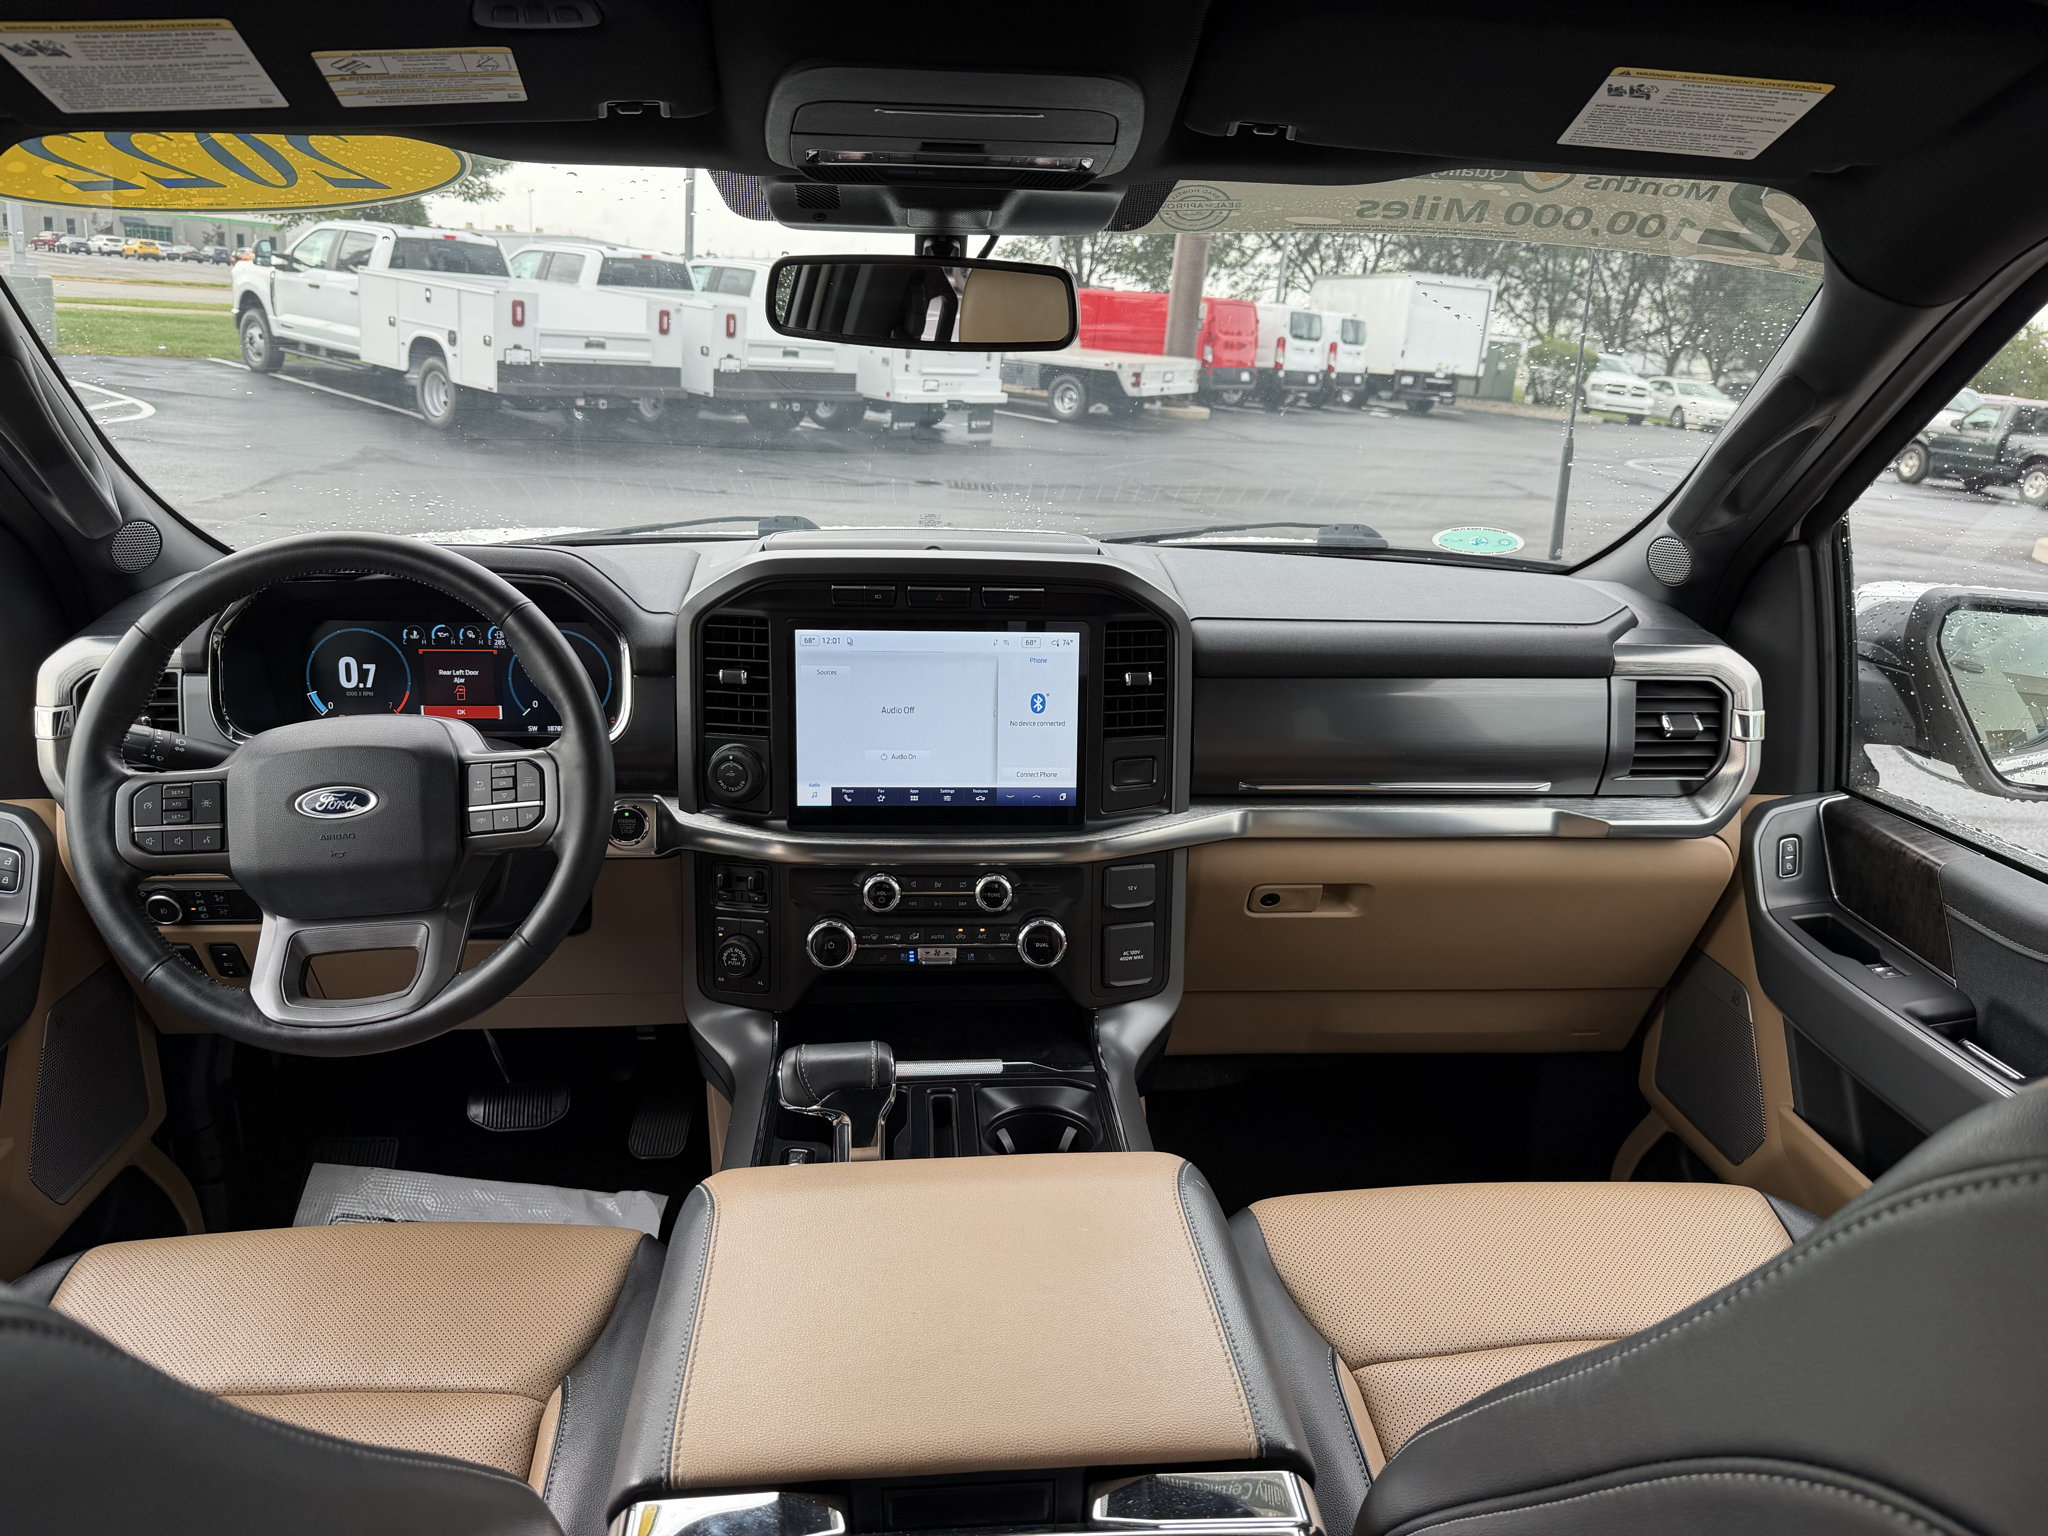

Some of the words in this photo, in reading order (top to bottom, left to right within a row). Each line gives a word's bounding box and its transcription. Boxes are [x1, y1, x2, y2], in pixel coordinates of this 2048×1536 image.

[822, 637, 841, 645] 12:01
[1062, 639, 1074, 647] 74°
[1029, 657, 1048, 665] Phone
[338, 656, 377, 689] 0.7
[327, 701, 334, 710] 0
[388, 701, 393, 710] 7
[532, 700, 539, 708] 0
[881, 706, 902, 715] Audio
[903, 706, 916, 715] Off
[1018, 719, 1038, 727] device
[1038, 719, 1066, 727] connected
[891, 753, 908, 761] Audio
[908, 753, 917, 761] On
[717, 779, 728, 790] PRO
[728, 780, 746, 792] TRAILER
[316, 792, 357, 811] Ford
[319, 833, 356, 841] AIRBAG
[722, 947, 734, 961] DRIVE
[734, 947, 747, 961] MODE
